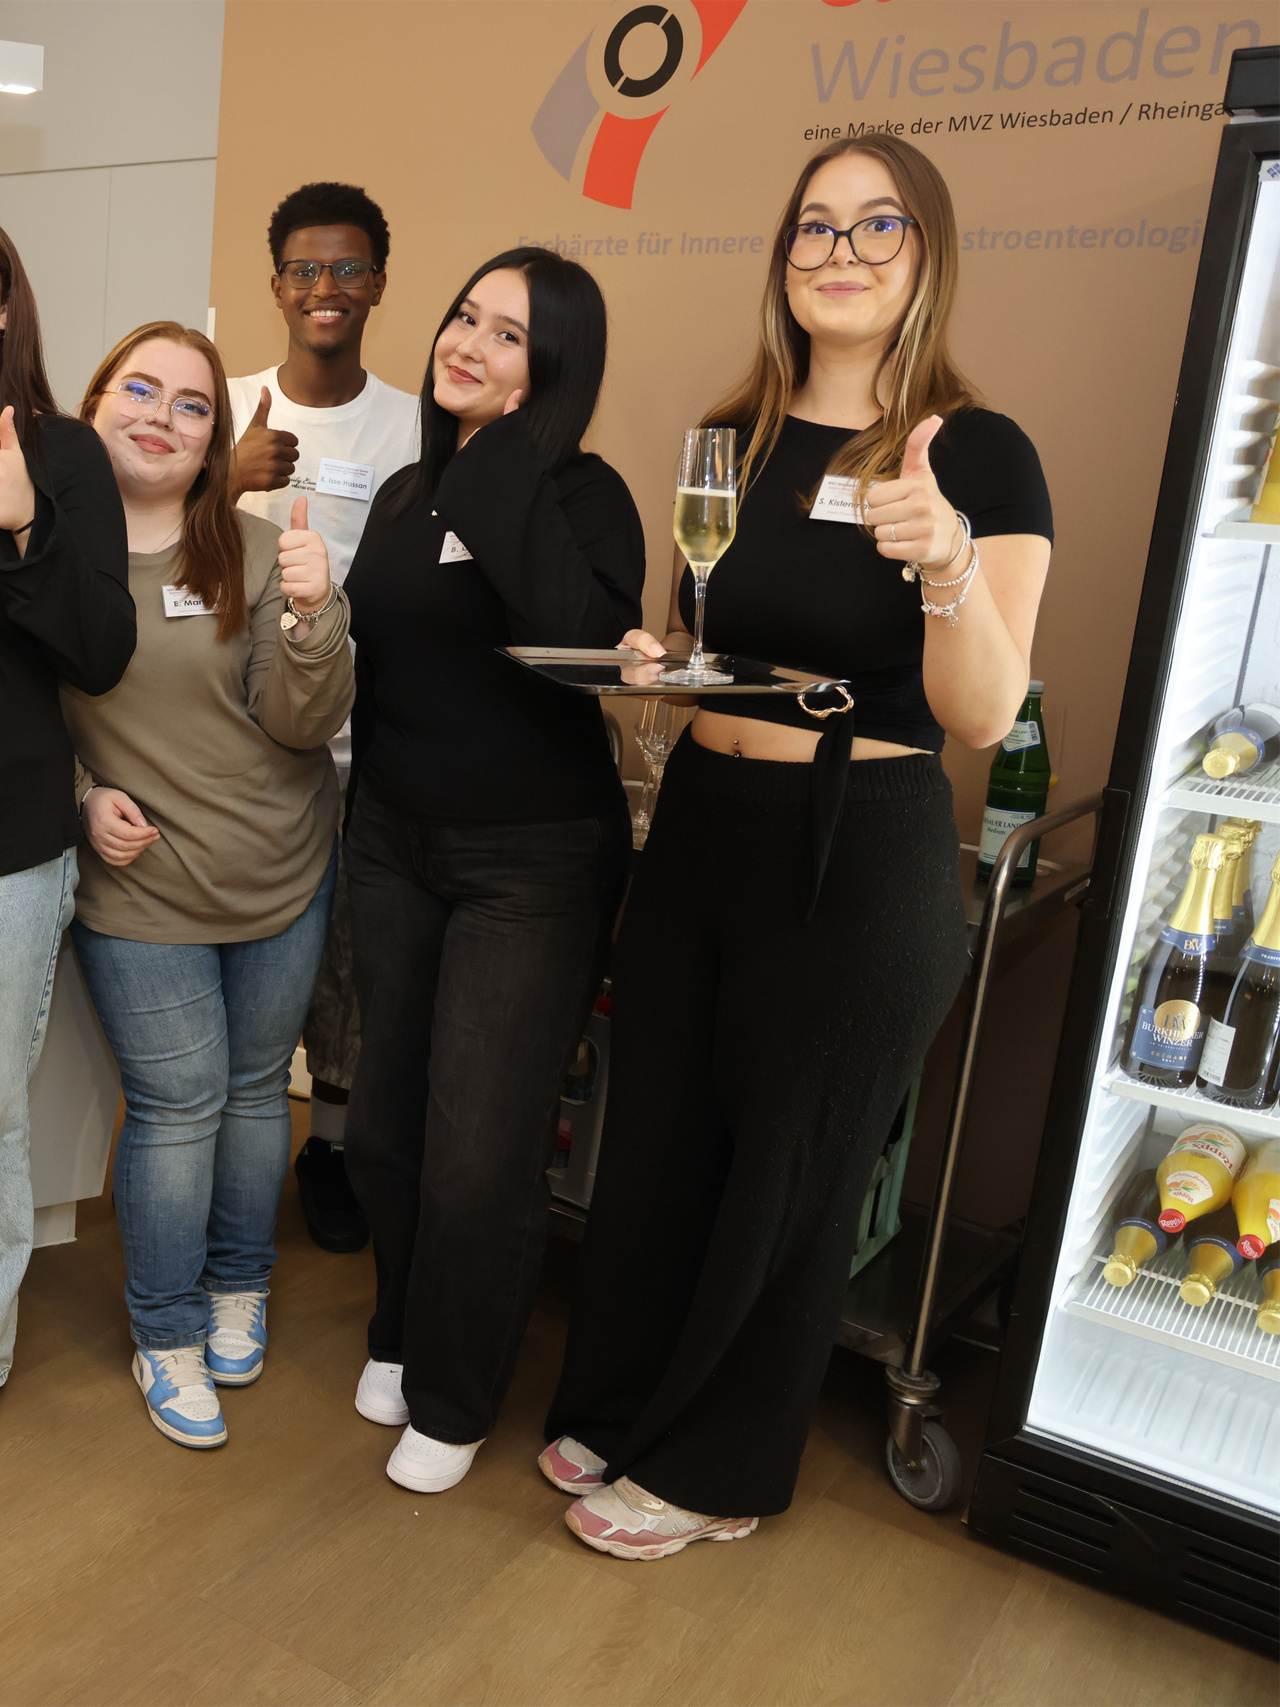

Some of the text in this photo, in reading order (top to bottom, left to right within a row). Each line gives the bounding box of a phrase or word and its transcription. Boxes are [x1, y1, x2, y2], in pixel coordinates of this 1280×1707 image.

[811, 8, 1261, 103] Wiesbaden
[804, 125, 841, 140] eine
[910, 118, 943, 134] der
[948, 114, 993, 132] MVZ
[1000, 107, 1113, 129] Wiesbaden
[1119, 103, 1133, 125] /
[637, 232, 674, 255] für
[681, 232, 764, 254] Innere
[329, 477, 341, 485] Isse
[343, 479, 367, 489] Hassan
[1142, 1021, 1204, 1039] BURKHEER
[1153, 1033, 1193, 1047] WINZER
[1192, 1143, 1233, 1169] Rapp's
[1160, 1217, 1182, 1229] Rapp's
